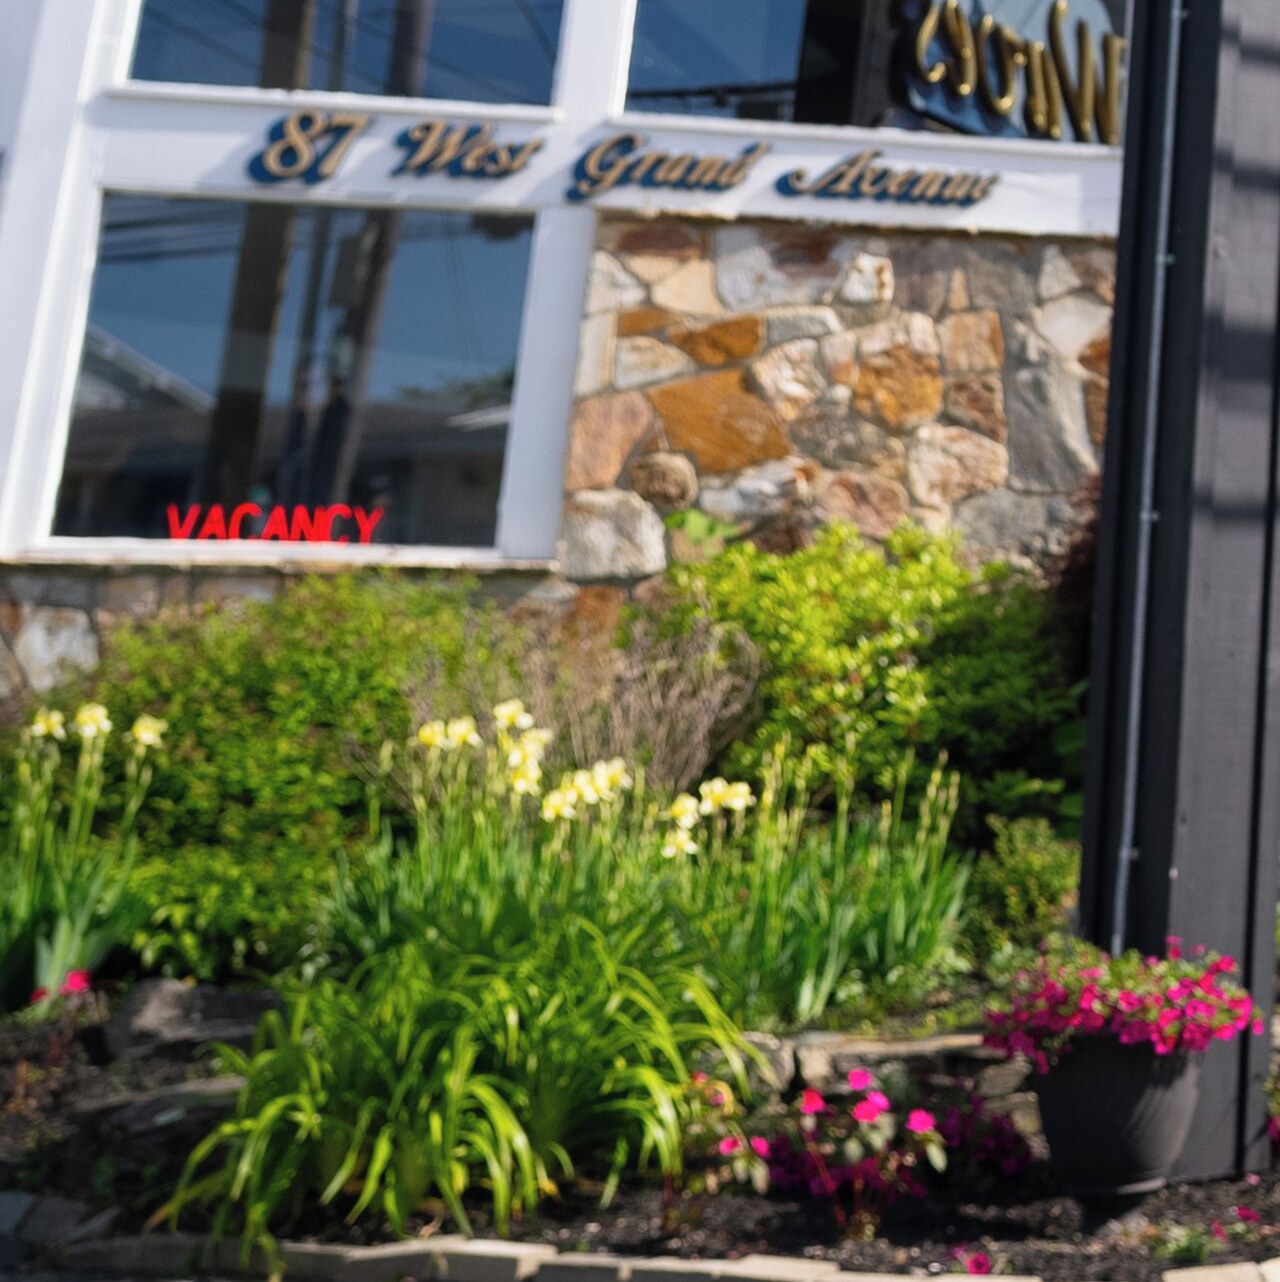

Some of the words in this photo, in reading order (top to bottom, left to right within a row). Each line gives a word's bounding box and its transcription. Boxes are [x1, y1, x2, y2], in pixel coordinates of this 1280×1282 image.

[256, 109, 369, 181] 87
[397, 121, 542, 176] West
[571, 132, 770, 199] Grand
[779, 149, 997, 204] Avenue
[166, 503, 385, 547] VACANCY
